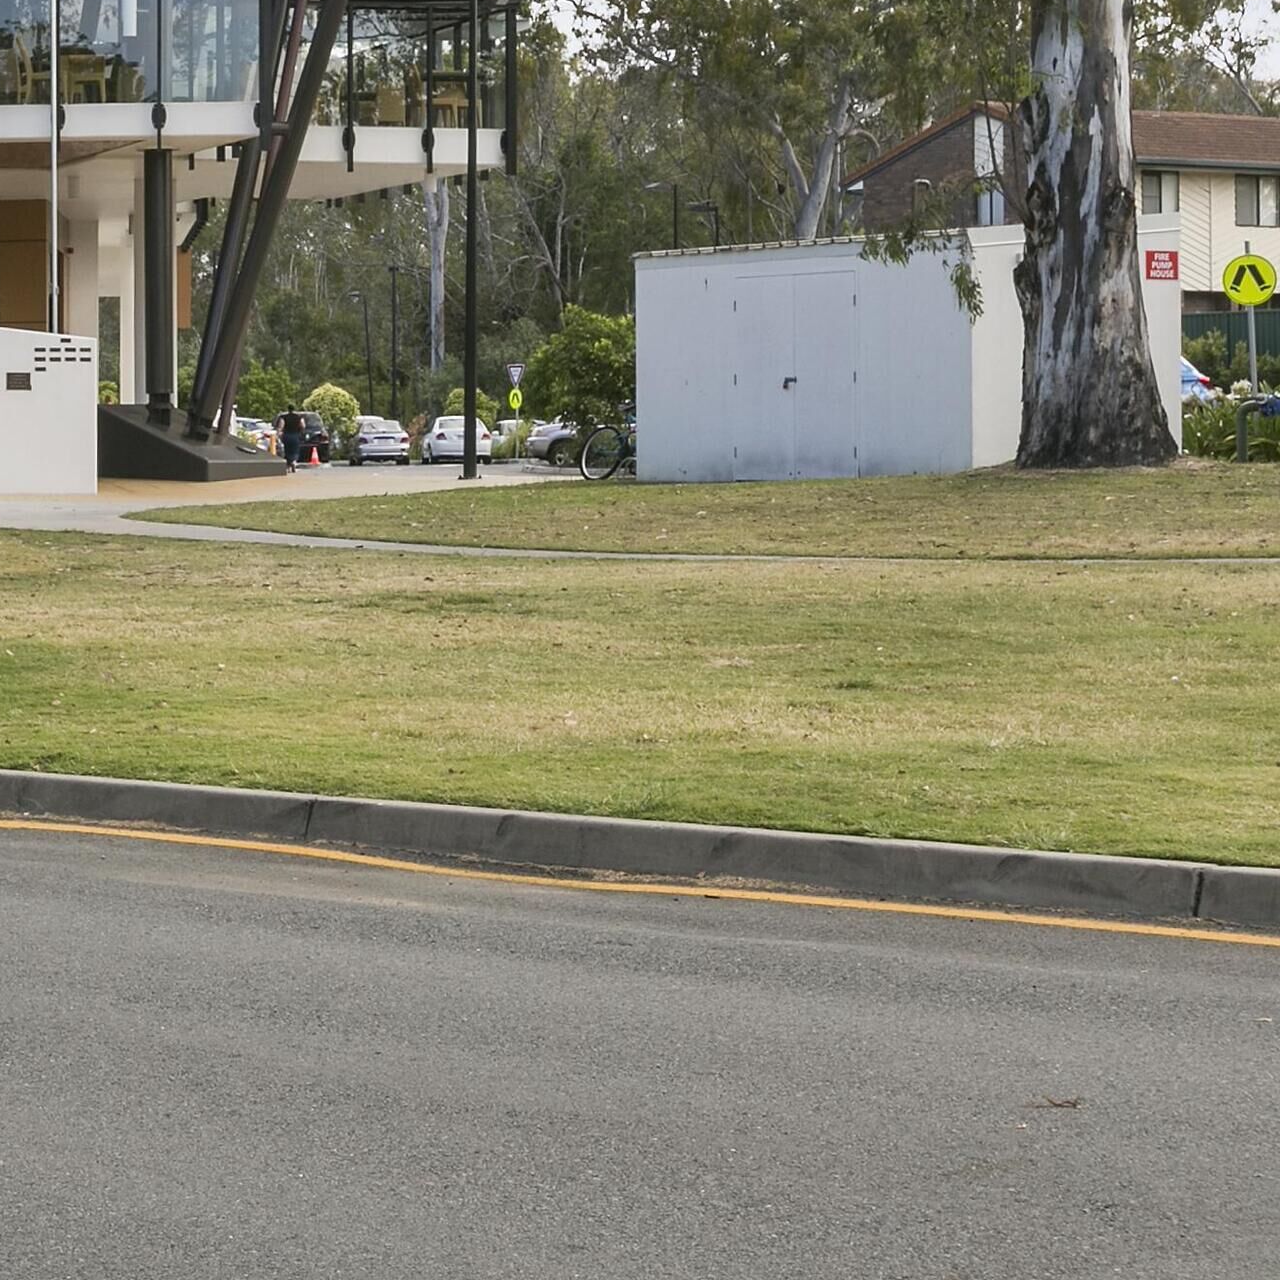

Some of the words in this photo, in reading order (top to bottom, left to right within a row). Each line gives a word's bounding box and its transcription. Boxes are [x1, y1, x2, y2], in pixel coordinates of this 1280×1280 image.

[1154, 252, 1170, 261] FIRE
[1151, 261, 1173, 270] PUMP
[1150, 269, 1175, 278] HOUSE
